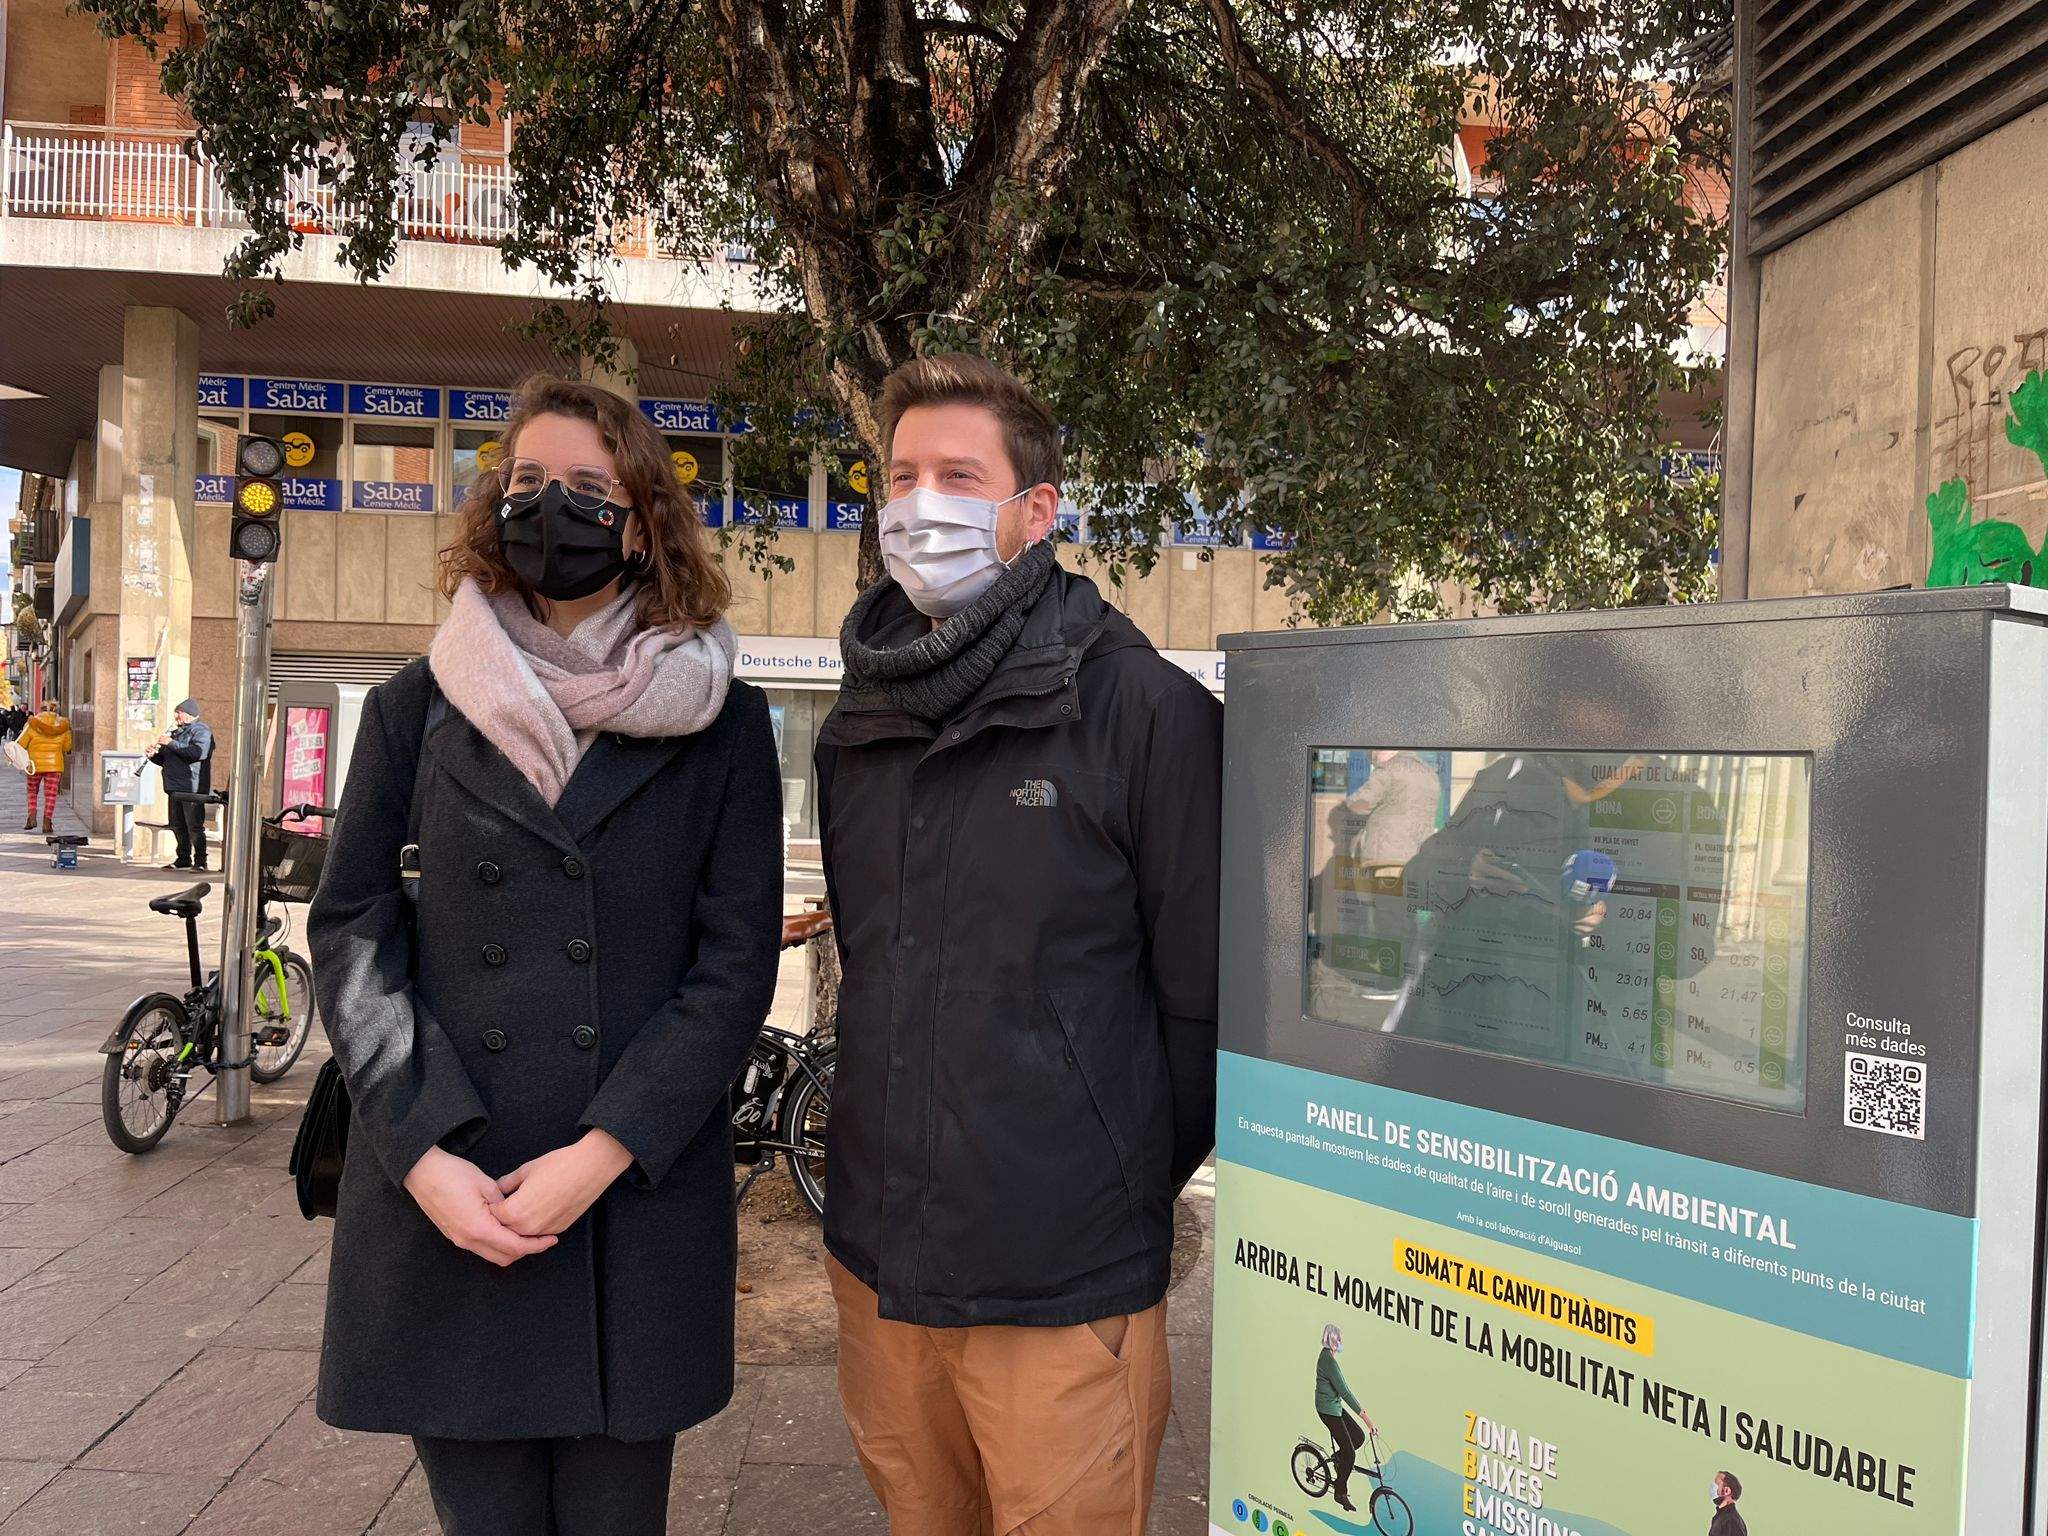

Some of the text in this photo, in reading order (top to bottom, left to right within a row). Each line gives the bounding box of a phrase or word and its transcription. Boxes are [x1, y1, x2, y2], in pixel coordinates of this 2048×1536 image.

[266, 380, 327, 392] Centre Mèdic
[364, 386, 423, 398] Centre Mèdic
[266, 389, 328, 410] Sabat
[464, 392, 493, 401] Centre
[364, 394, 424, 416] Sabat
[464, 401, 511, 420] Saba
[654, 402, 681, 412] Centre
[654, 411, 710, 430] Sabat
[282, 478, 327, 498] abat
[363, 482, 423, 502] Sabat
[297, 497, 326, 506] Mèdic
[394, 502, 422, 510] Mèdic
[742, 654, 844, 669] Deutsche Ban
[1592, 765, 1644, 782] QUALITAT
[1646, 767, 1660, 782] DE
[1024, 780, 1042, 789] THE
[1010, 788, 1040, 798] NORTH
[1016, 797, 1040, 806] FACE
[1596, 800, 1622, 816] BONA
[1697, 806, 1727, 820] BONA
[1618, 907, 1652, 920] 20,84
[1625, 942, 1650, 954] 1,09
[1616, 973, 1648, 988] 23,01
[1720, 988, 1758, 1004] 21,47
[1622, 1007, 1648, 1020] 5,65
[1846, 1012, 1911, 1035] Consulta
[1749, 1026, 1755, 1039] 1
[1627, 1042, 1646, 1054] 4,1
[1846, 1032, 1926, 1056] més dades
[1734, 1060, 1755, 1074] 0,5
[1306, 1101, 1797, 1250] PANELL DE SENSIBILITZACIÓ AMBIENTAL
[1238, 1116, 1926, 1315] En aquesta pantalla mostrem les dades de qualitat de l'aire i de soroll generades pel trànsit a diferents punts de la ciutat
[1456, 1212, 1474, 1223] Amb
[1476, 1216, 1482, 1226] la
[1538, 1234, 1582, 1256] d'Aiguasol
[1404, 1246, 1637, 1345] SUMA'T AL CANVI D'HÀBITS
[1234, 1238, 1916, 1508] ARRIBA EL MOMENT DE LA MOBILITAT NETA I SALUDABLE
[1464, 1410, 1558, 1480] ZONA DE
[1464, 1448, 1543, 1510] BAIXES
